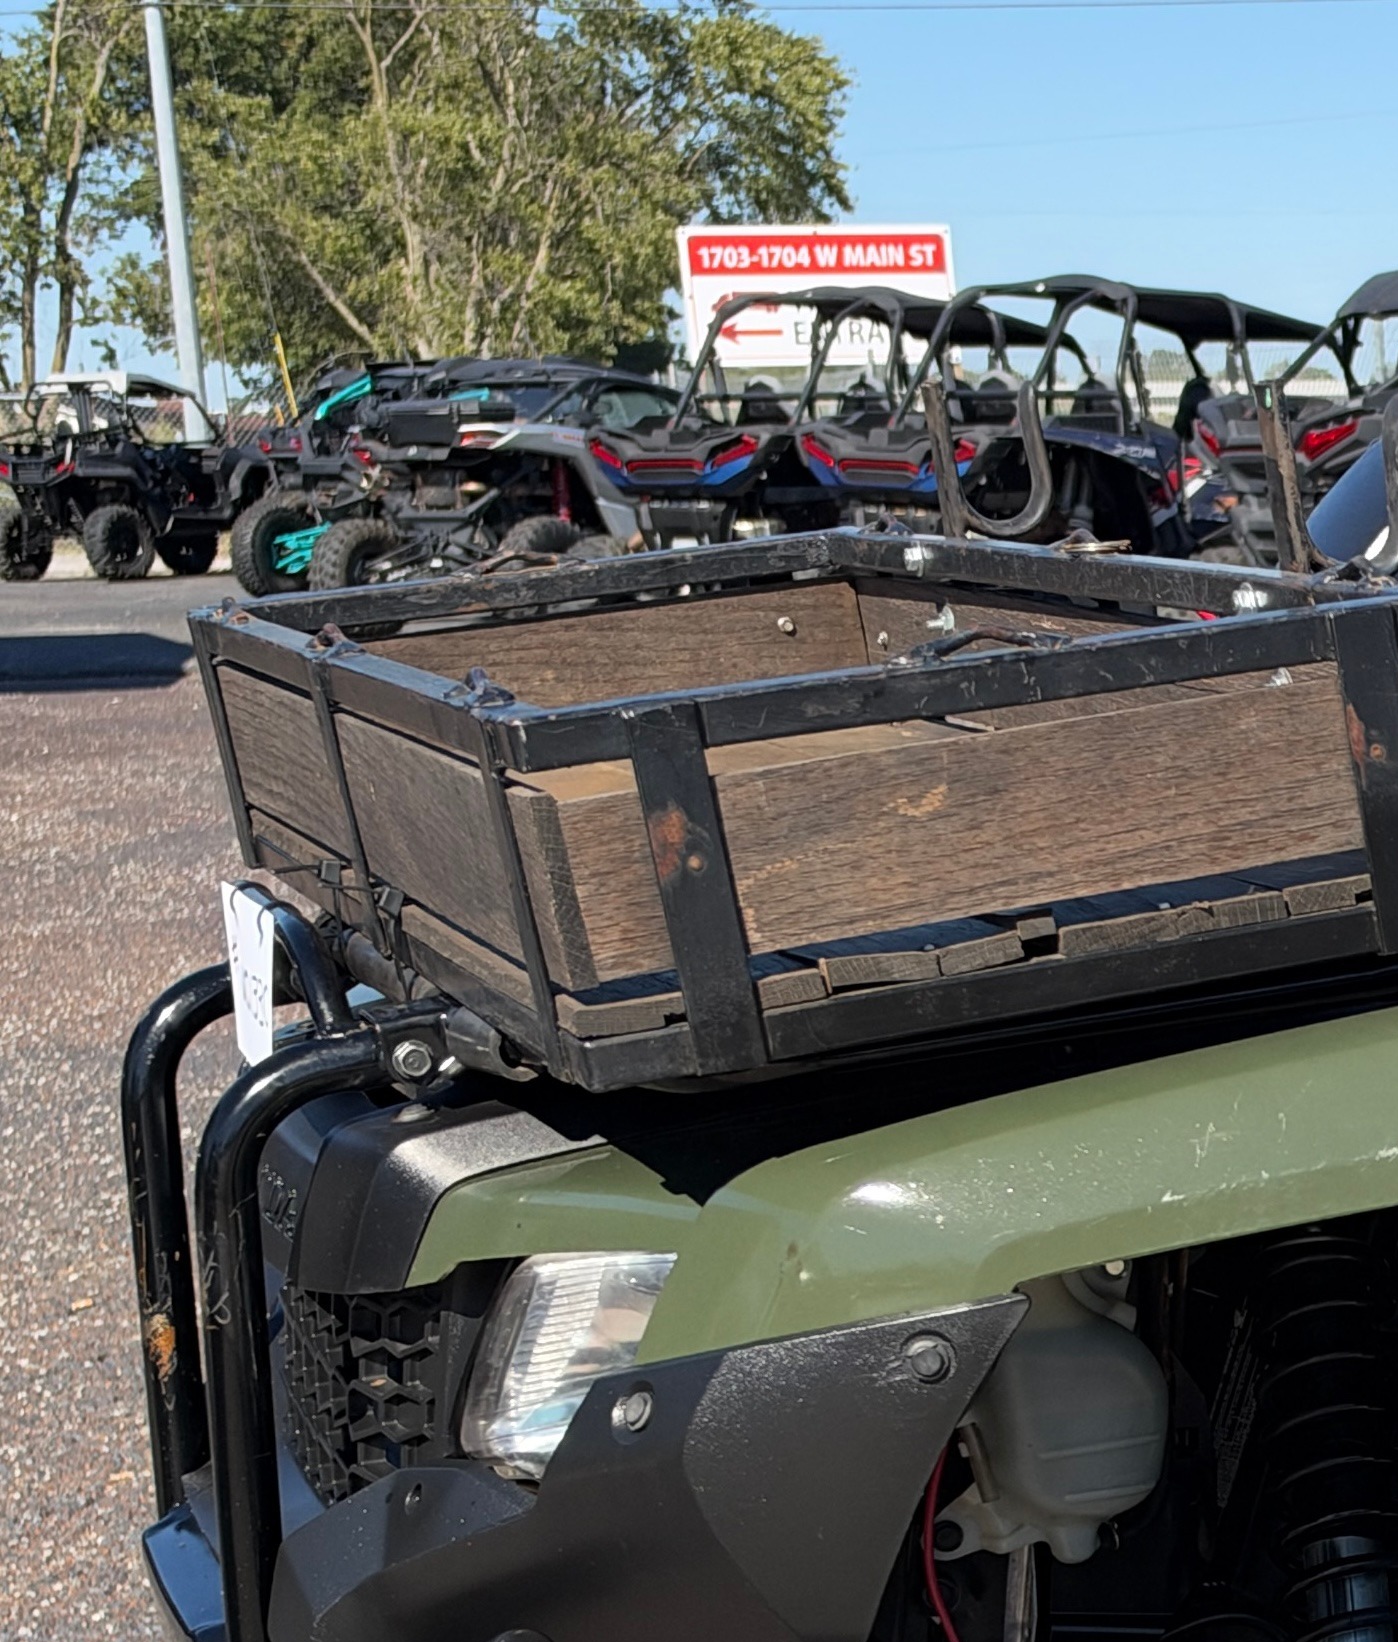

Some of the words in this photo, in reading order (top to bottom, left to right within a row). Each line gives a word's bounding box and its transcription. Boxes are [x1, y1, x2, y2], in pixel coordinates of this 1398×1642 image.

[698, 245, 811, 268] 1703-1704
[814, 244, 838, 267] W
[843, 244, 904, 267] MAIN
[909, 243, 937, 267] ST
